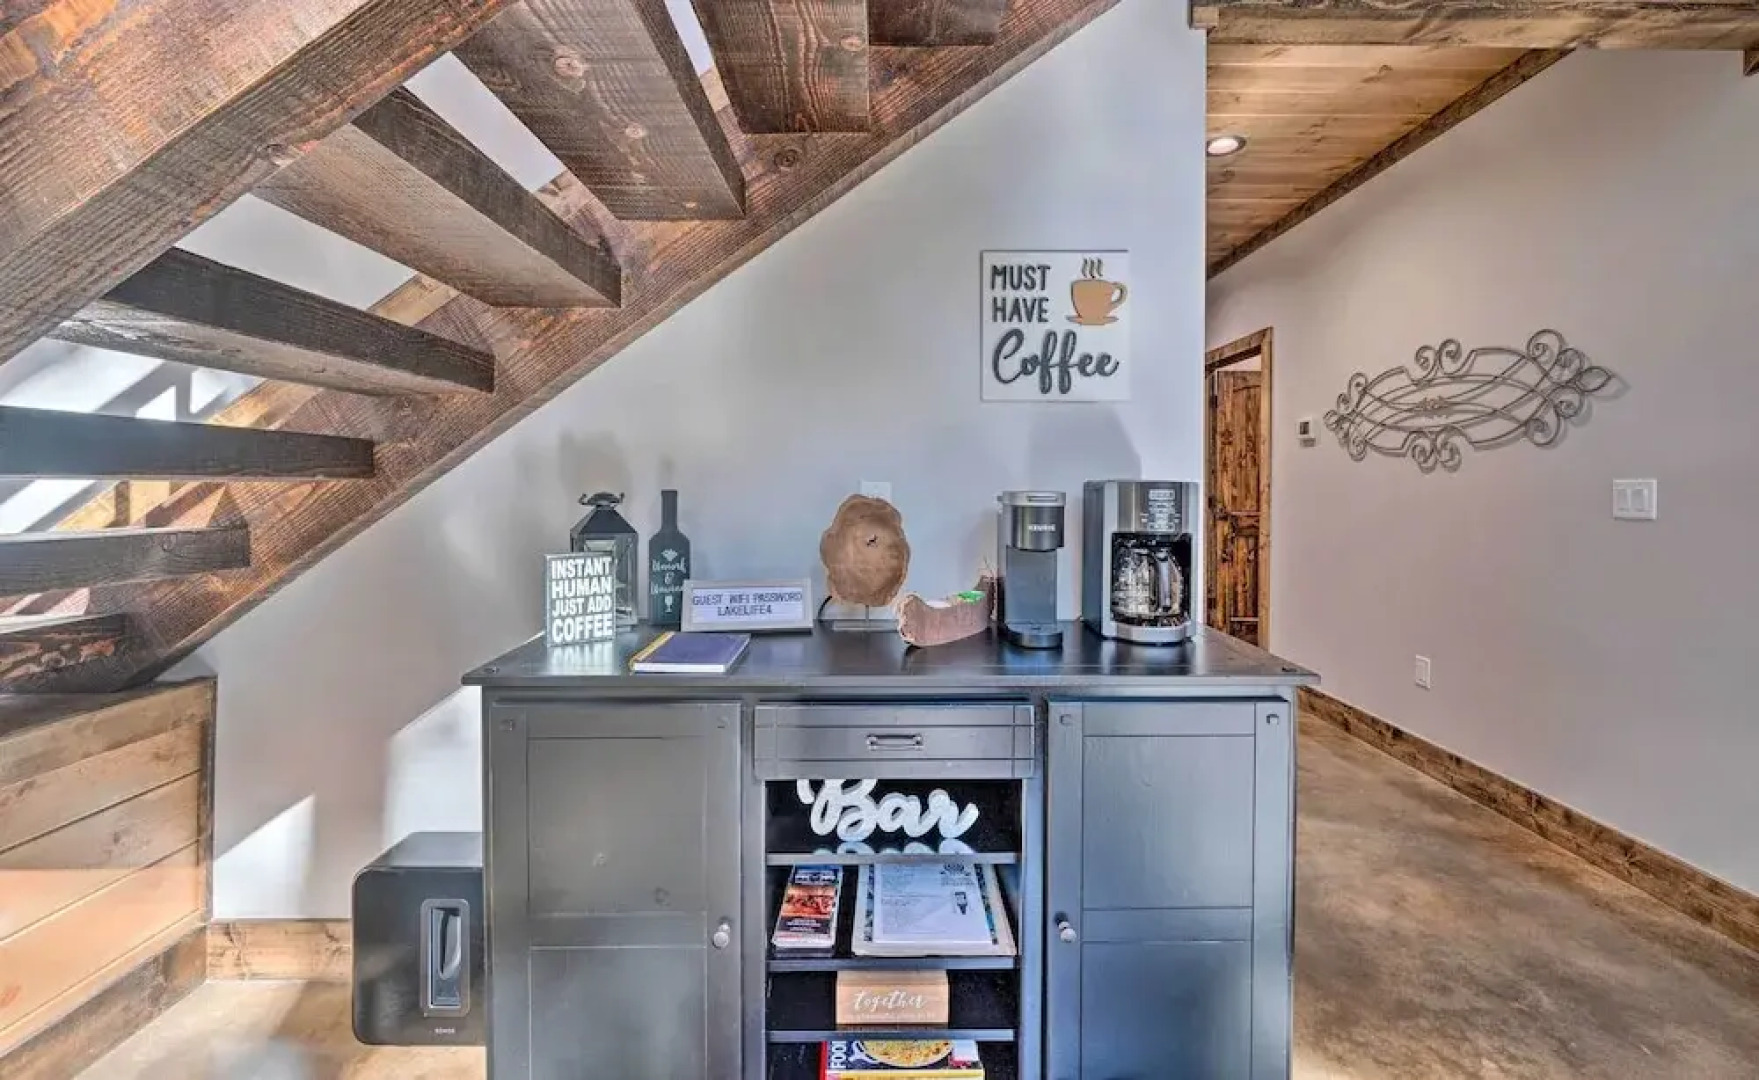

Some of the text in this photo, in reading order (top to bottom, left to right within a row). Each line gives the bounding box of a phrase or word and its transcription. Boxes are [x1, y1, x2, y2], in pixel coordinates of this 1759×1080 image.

[991, 264, 1051, 290] MUST
[992, 297, 1049, 323] HAVE
[992, 329, 1120, 394] Coffee
[551, 557, 611, 579] INSTANT
[551, 576, 612, 599] HUMAN
[693, 591, 802, 606] GUEST WIFI PASSWORD
[551, 595, 611, 617] JUST ADD
[717, 604, 772, 616] LAKELIFE4
[551, 613, 612, 643] COFFEE
[796, 778, 979, 842] Bar
[854, 990, 927, 1012] together
